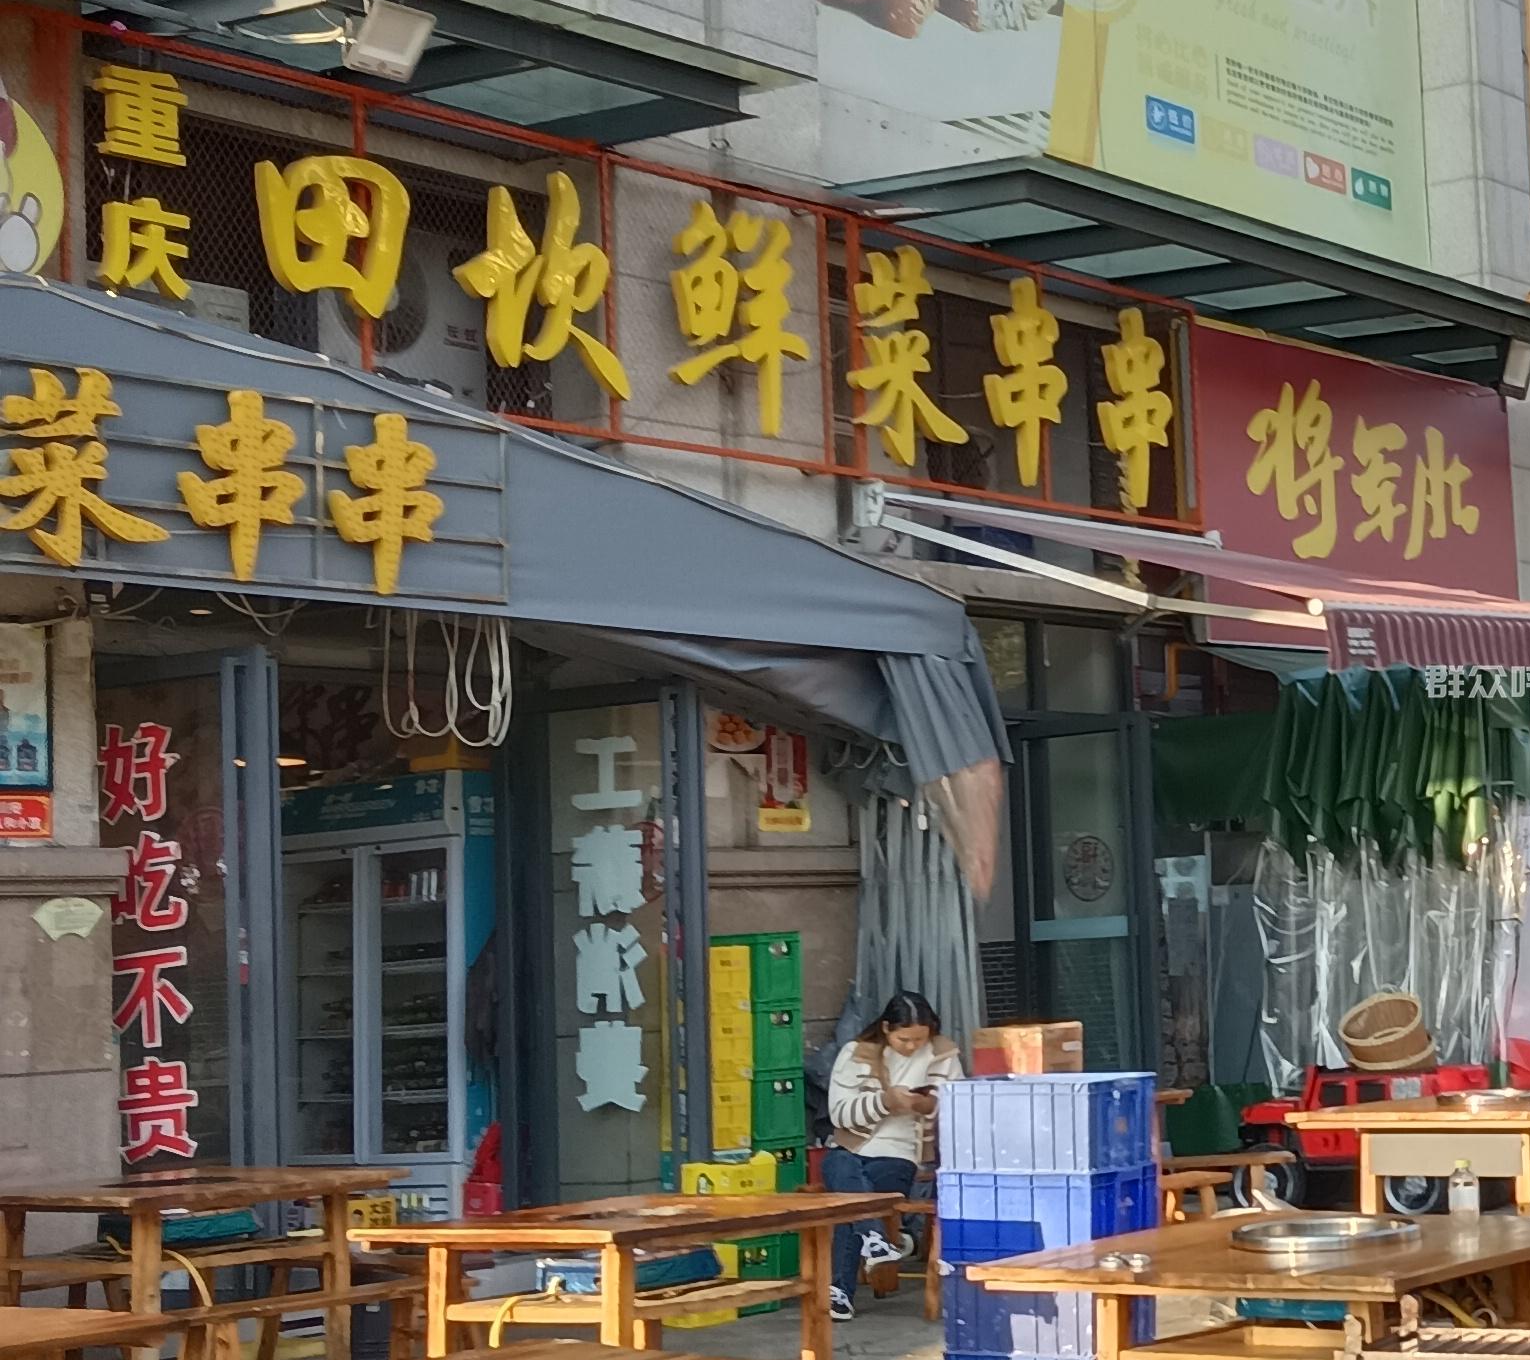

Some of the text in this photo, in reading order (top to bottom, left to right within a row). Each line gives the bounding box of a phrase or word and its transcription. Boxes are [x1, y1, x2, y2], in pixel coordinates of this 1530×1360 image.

[93, 64, 191, 300] 重庆
[0, 366, 444, 595] 菜串串
[101, 721, 198, 1165] 好吃不贵
